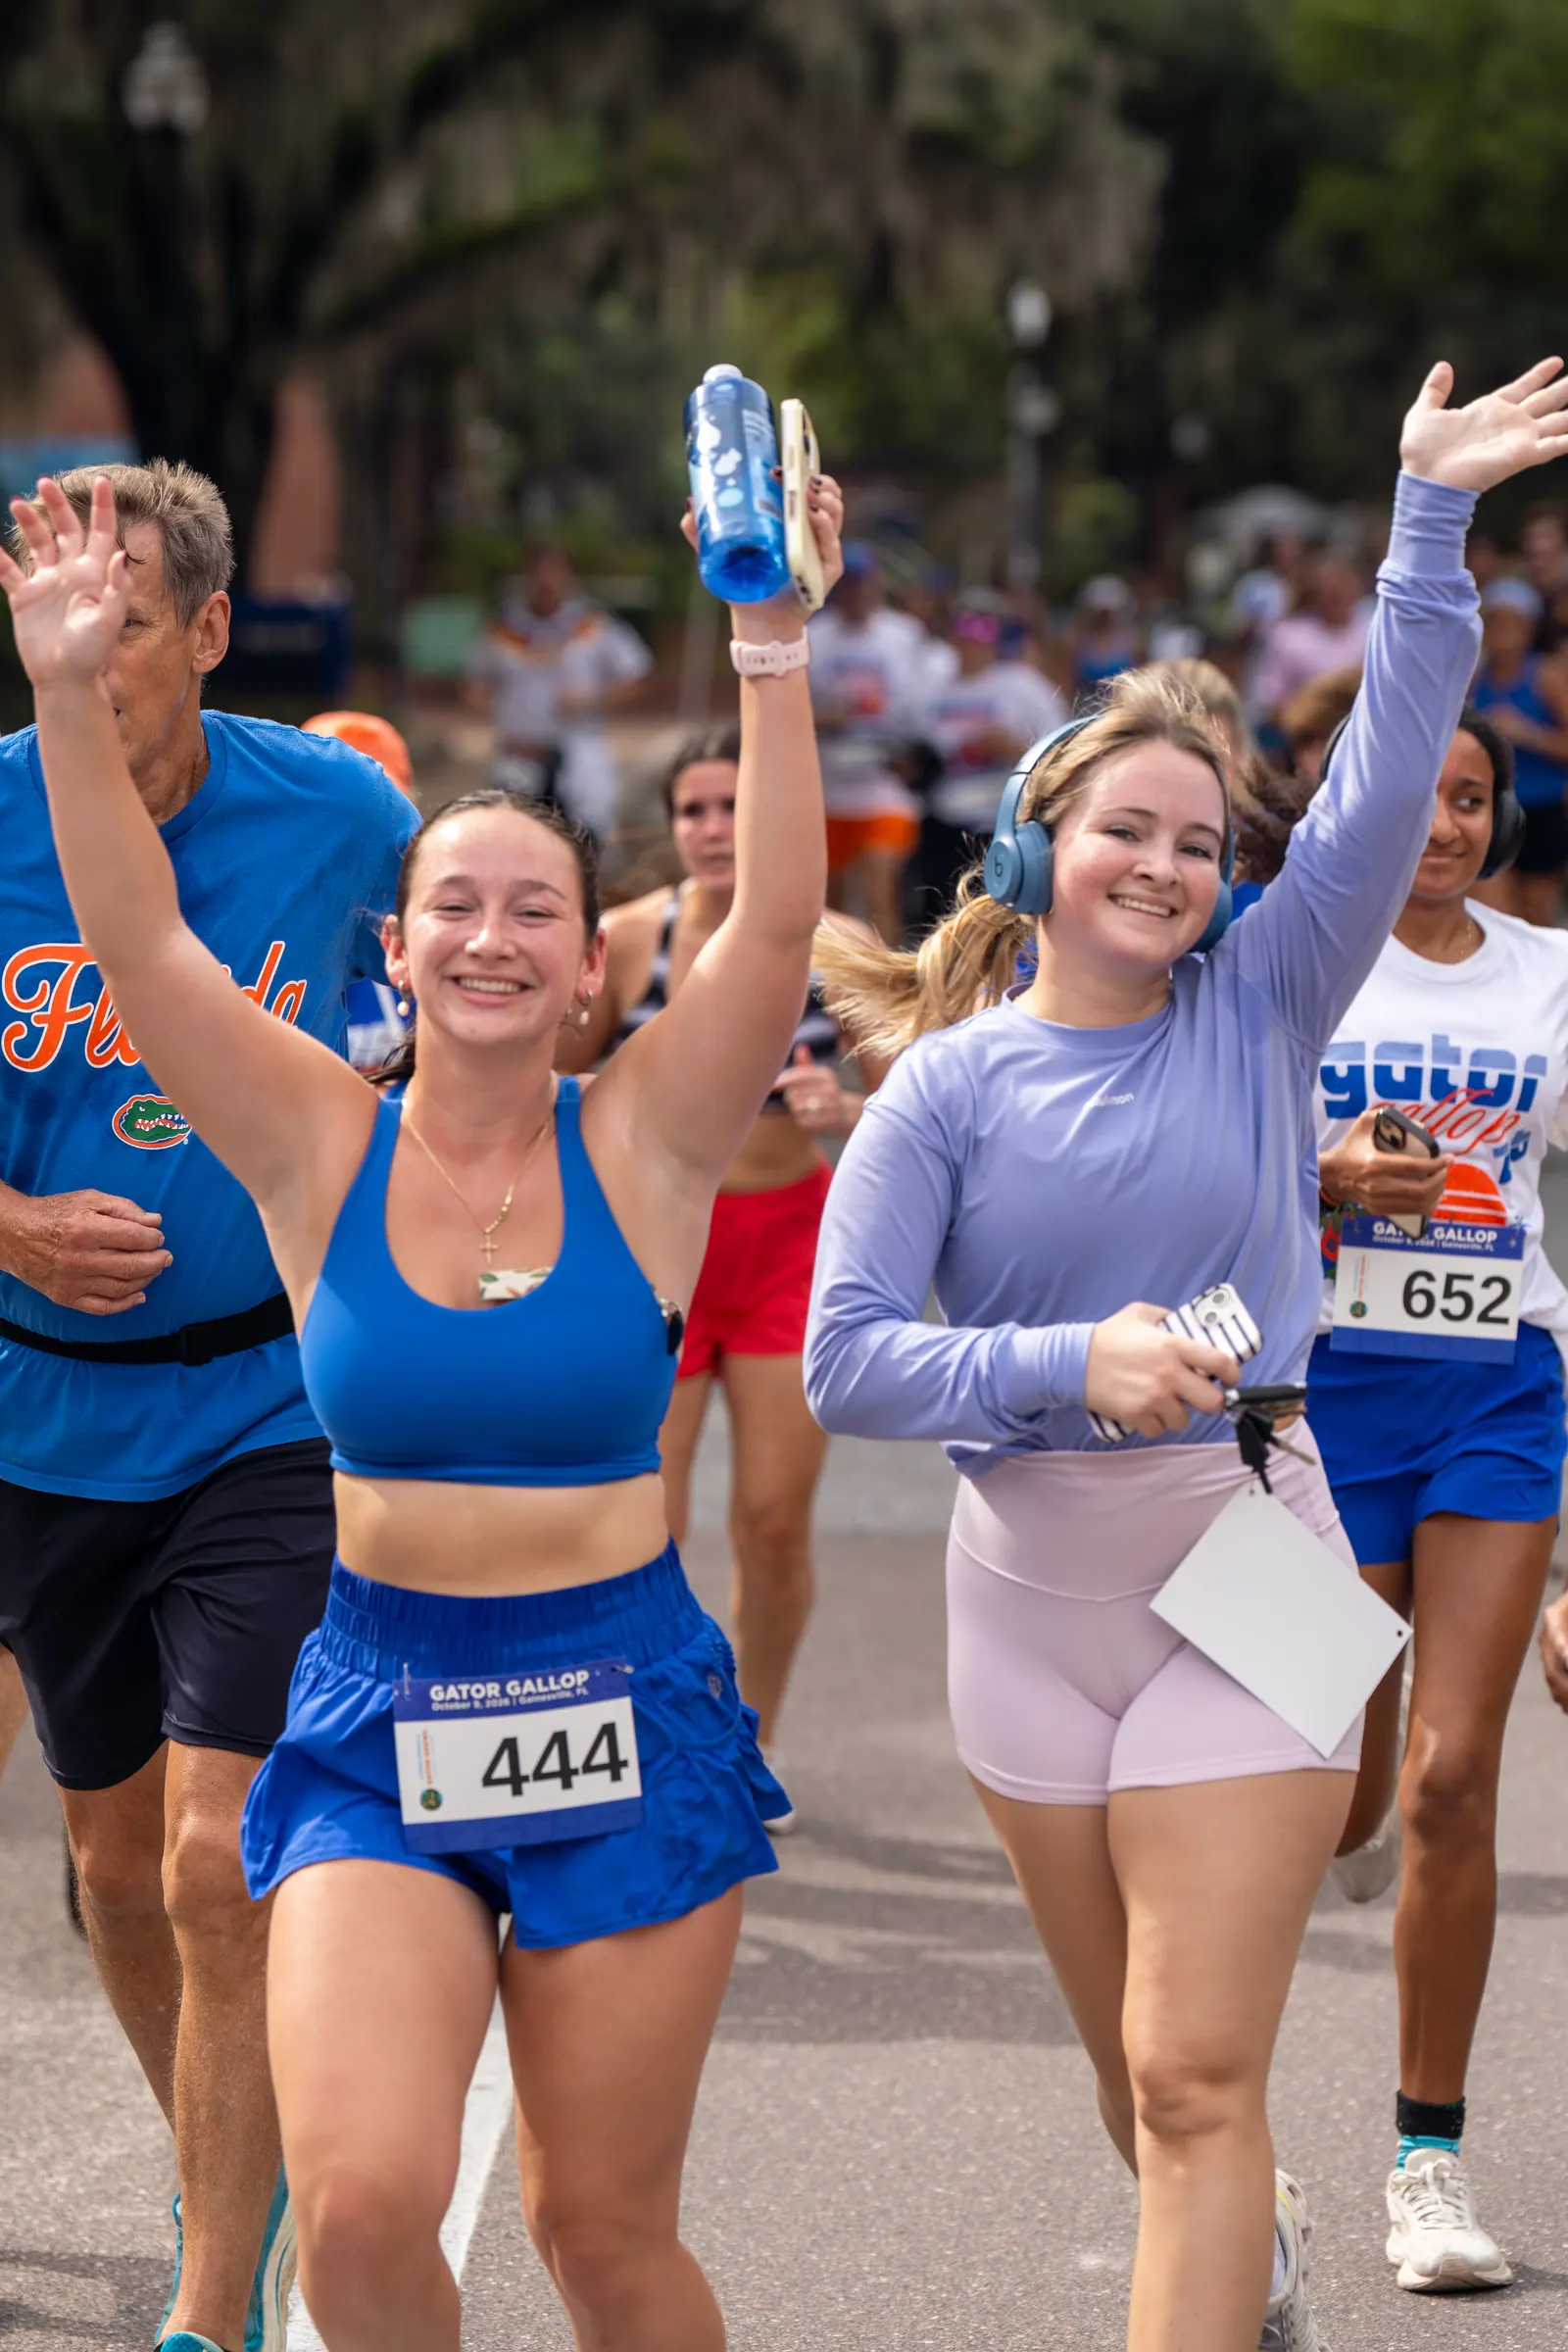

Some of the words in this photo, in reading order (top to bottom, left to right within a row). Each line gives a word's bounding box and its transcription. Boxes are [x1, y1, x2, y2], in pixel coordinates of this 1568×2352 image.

[1320, 1034, 1547, 1119] gator
[1372, 1088, 1521, 1157] allop
[1433, 1226, 1498, 1244] GALLOP
[1402, 1270, 1512, 1325] 652
[429, 1681, 502, 1702] GATOR
[506, 1669, 590, 1696] GALLOP
[431, 1700, 470, 1711] October
[481, 1721, 628, 1797] 444
